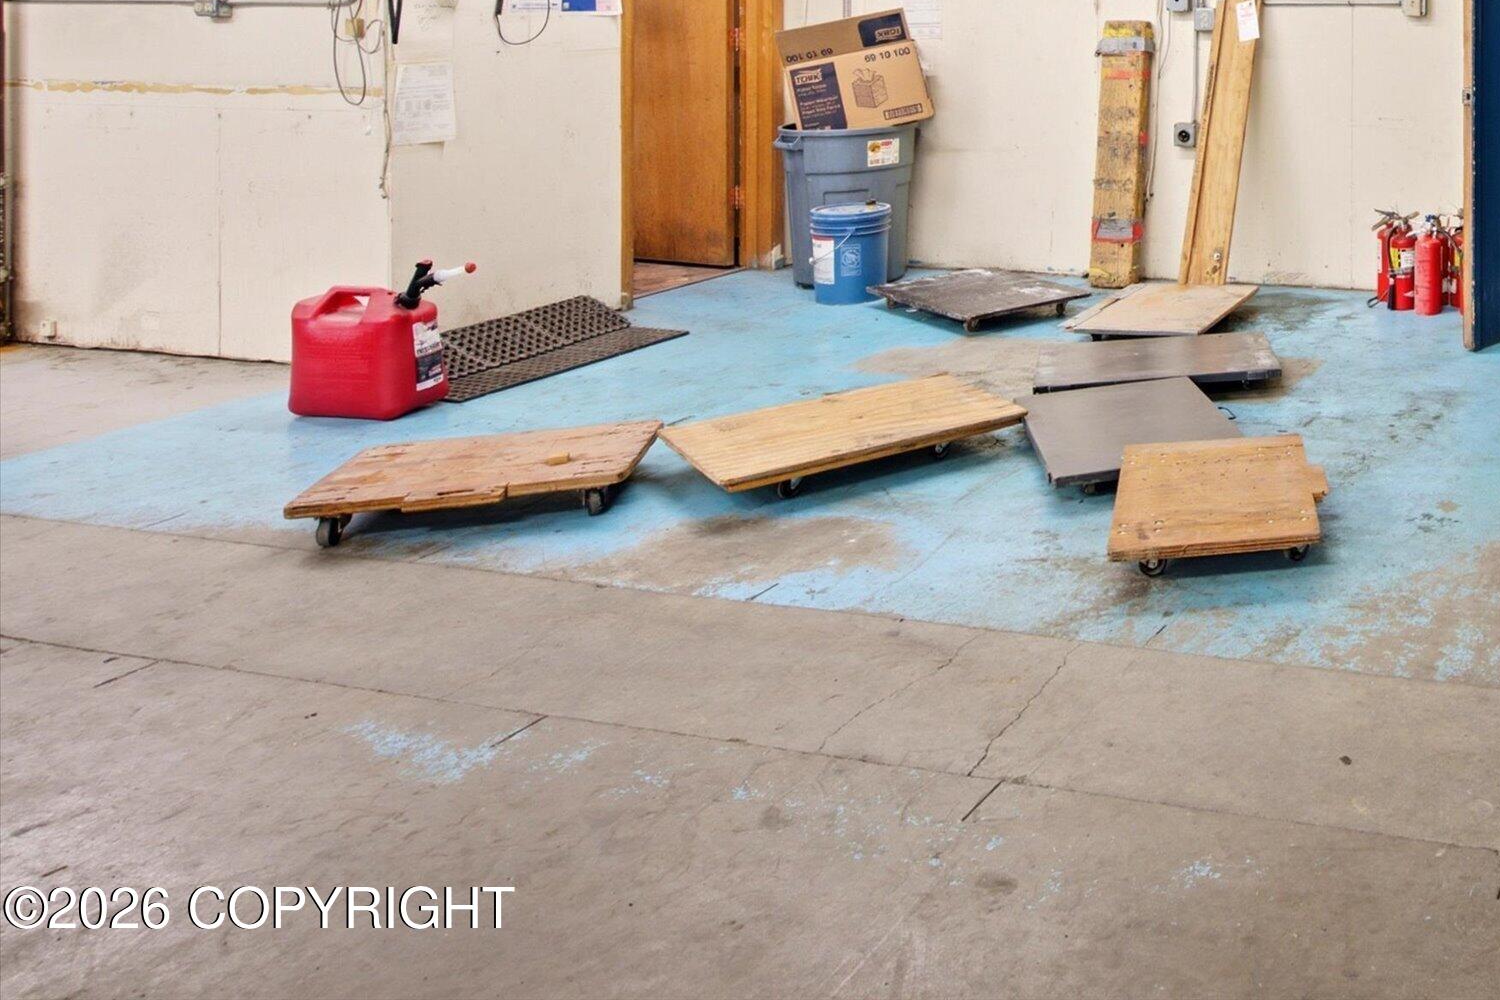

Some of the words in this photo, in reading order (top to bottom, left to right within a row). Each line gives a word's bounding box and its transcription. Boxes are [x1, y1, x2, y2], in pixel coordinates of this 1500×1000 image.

[879, 50, 891, 60] 10
[893, 46, 911, 58] 100
[795, 73, 821, 84] TORK
